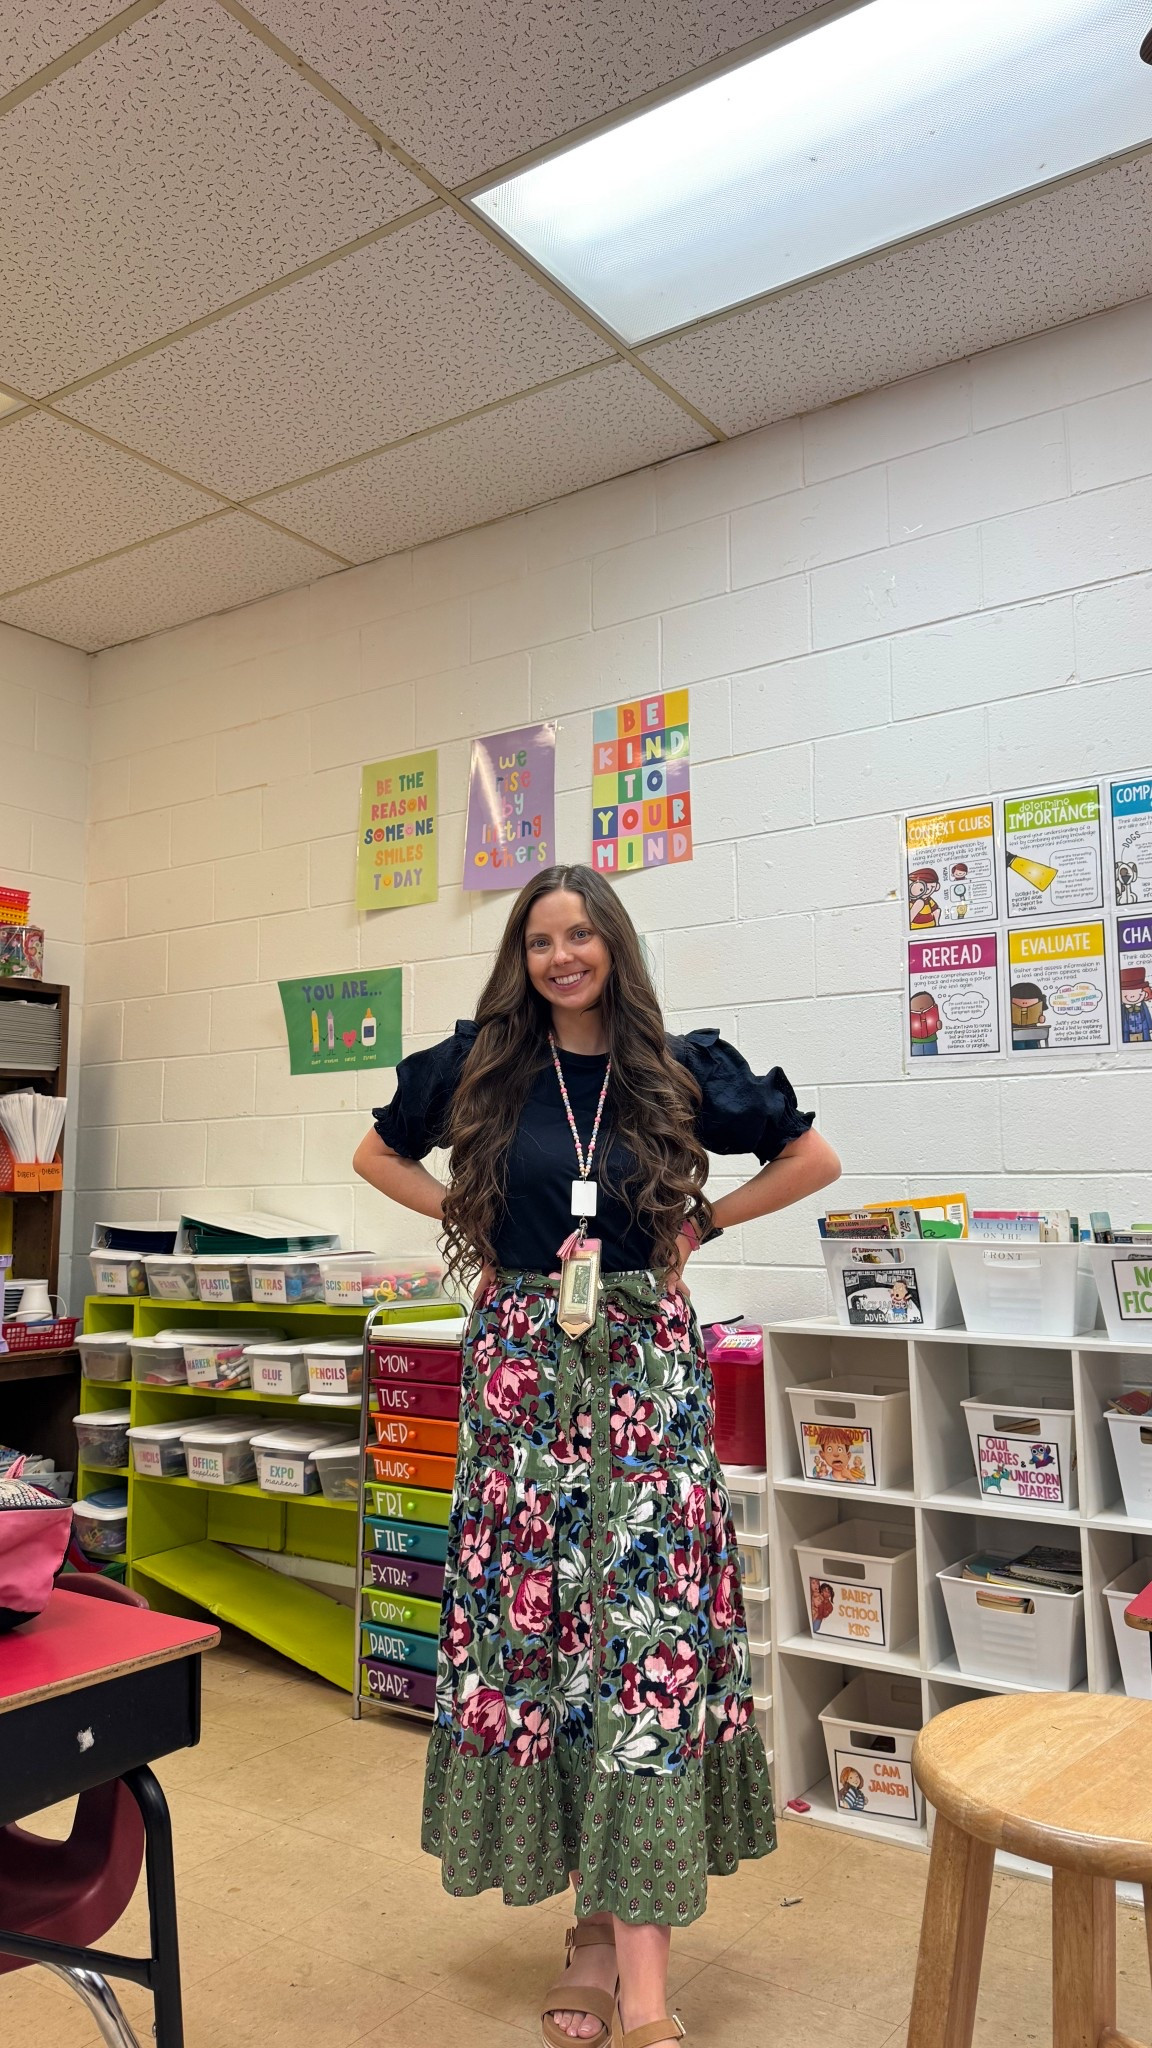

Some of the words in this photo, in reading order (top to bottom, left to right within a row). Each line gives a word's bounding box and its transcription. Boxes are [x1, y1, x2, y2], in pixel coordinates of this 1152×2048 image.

[623, 702, 659, 733] BE
[499, 750, 527, 770] we
[599, 730, 684, 770] KIND
[376, 778, 392, 797] BE
[399, 771, 424, 792] THE
[495, 770, 531, 793] rise
[624, 769, 663, 799] TO
[370, 795, 428, 822] REASON
[501, 792, 524, 817] by
[1019, 798, 1070, 813] determine
[597, 798, 685, 836] YOUR
[1008, 801, 1096, 830] IMPORTANCE
[364, 817, 434, 845] SOMEONE
[909, 820, 956, 841] CONTEXT
[958, 815, 991, 832] CLUES
[596, 832, 687, 868] MIND
[1122, 831, 1141, 849] DOGS
[374, 844, 424, 867] SMILES
[474, 842, 547, 869] others
[373, 868, 423, 891] TODAY
[1021, 932, 1091, 956] EVALUATE
[1122, 926, 1152, 944] CHA
[922, 944, 982, 968] REREAD
[302, 983, 335, 1003] YOU
[971, 1221, 993, 1230] ALL
[996, 1222, 1034, 1232] QUIET
[983, 1251, 1023, 1261] FRONT
[158, 1280, 182, 1290] PAINT
[200, 1278, 230, 1290] PLASTIC
[254, 1277, 283, 1291] EXTRAS
[325, 1280, 361, 1292] SCISSORS
[208, 1290, 223, 1299] bags
[262, 1367, 283, 1381] GLUE
[309, 1366, 346, 1380] PENCILS
[379, 1355, 408, 1374] MON
[379, 1388, 409, 1409] TUES
[378, 1421, 408, 1444] WED
[985, 1437, 1010, 1452] OWL
[192, 1456, 219, 1471] OFFICE
[980, 1448, 1020, 1466] DIARIES
[191, 1469, 221, 1478] supplies
[270, 1465, 294, 1480] EXPO
[373, 1458, 410, 1479] THURS
[1010, 1470, 1060, 1487] UNICORN
[264, 1477, 300, 1488] markers
[1018, 1483, 1060, 1500] DIARIES
[376, 1491, 404, 1518] FRI
[374, 1528, 408, 1553] FILE
[370, 1563, 409, 1588] EXTRA
[840, 1587, 874, 1605] BAILEY
[371, 1600, 406, 1623] COPY
[838, 1604, 880, 1623] SCHOOL
[847, 1622, 871, 1638] KIDS
[369, 1632, 406, 1661] PAPER
[367, 1669, 410, 1699] GRADE
[873, 1763, 902, 1780] CAM
[868, 1779, 910, 1798] JANSEN
